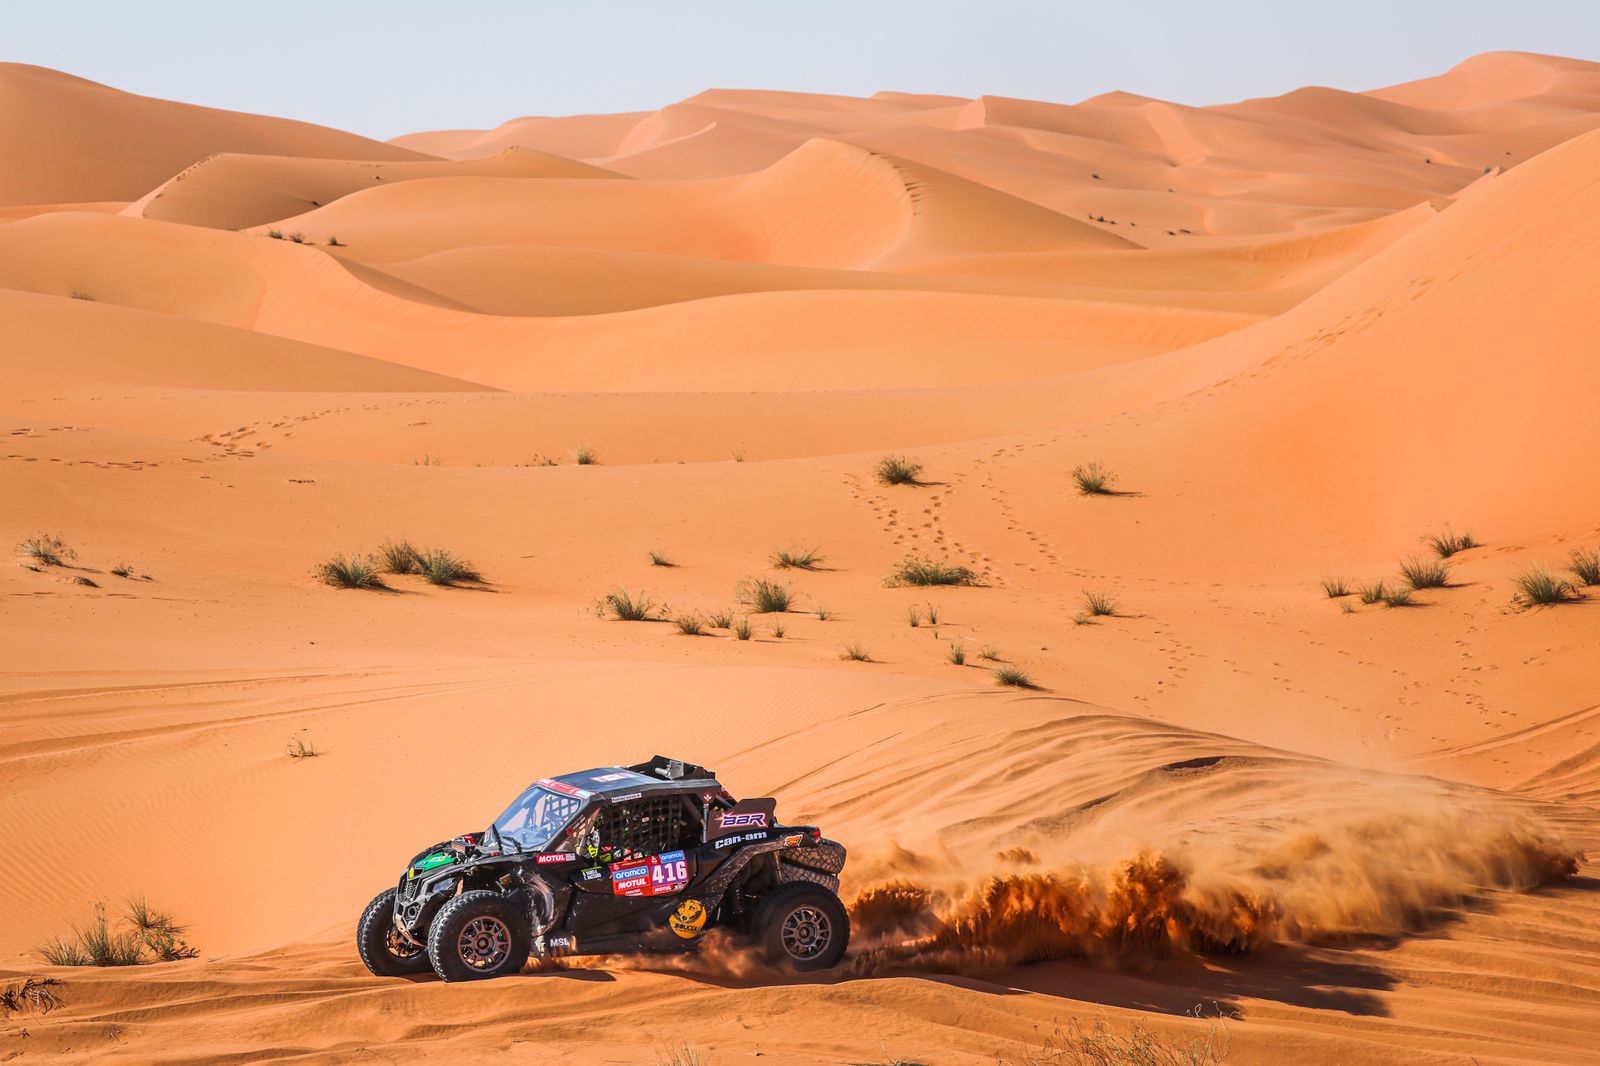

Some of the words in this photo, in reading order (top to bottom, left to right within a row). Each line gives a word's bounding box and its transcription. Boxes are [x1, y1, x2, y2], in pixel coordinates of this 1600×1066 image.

[721, 813, 766, 826] BBR
[715, 831, 767, 849] can-am
[539, 854, 566, 863] MOTUL
[661, 852, 683, 861] aramco
[615, 867, 647, 880] aramco
[652, 860, 688, 884] 416
[618, 877, 647, 890] MOTUL
